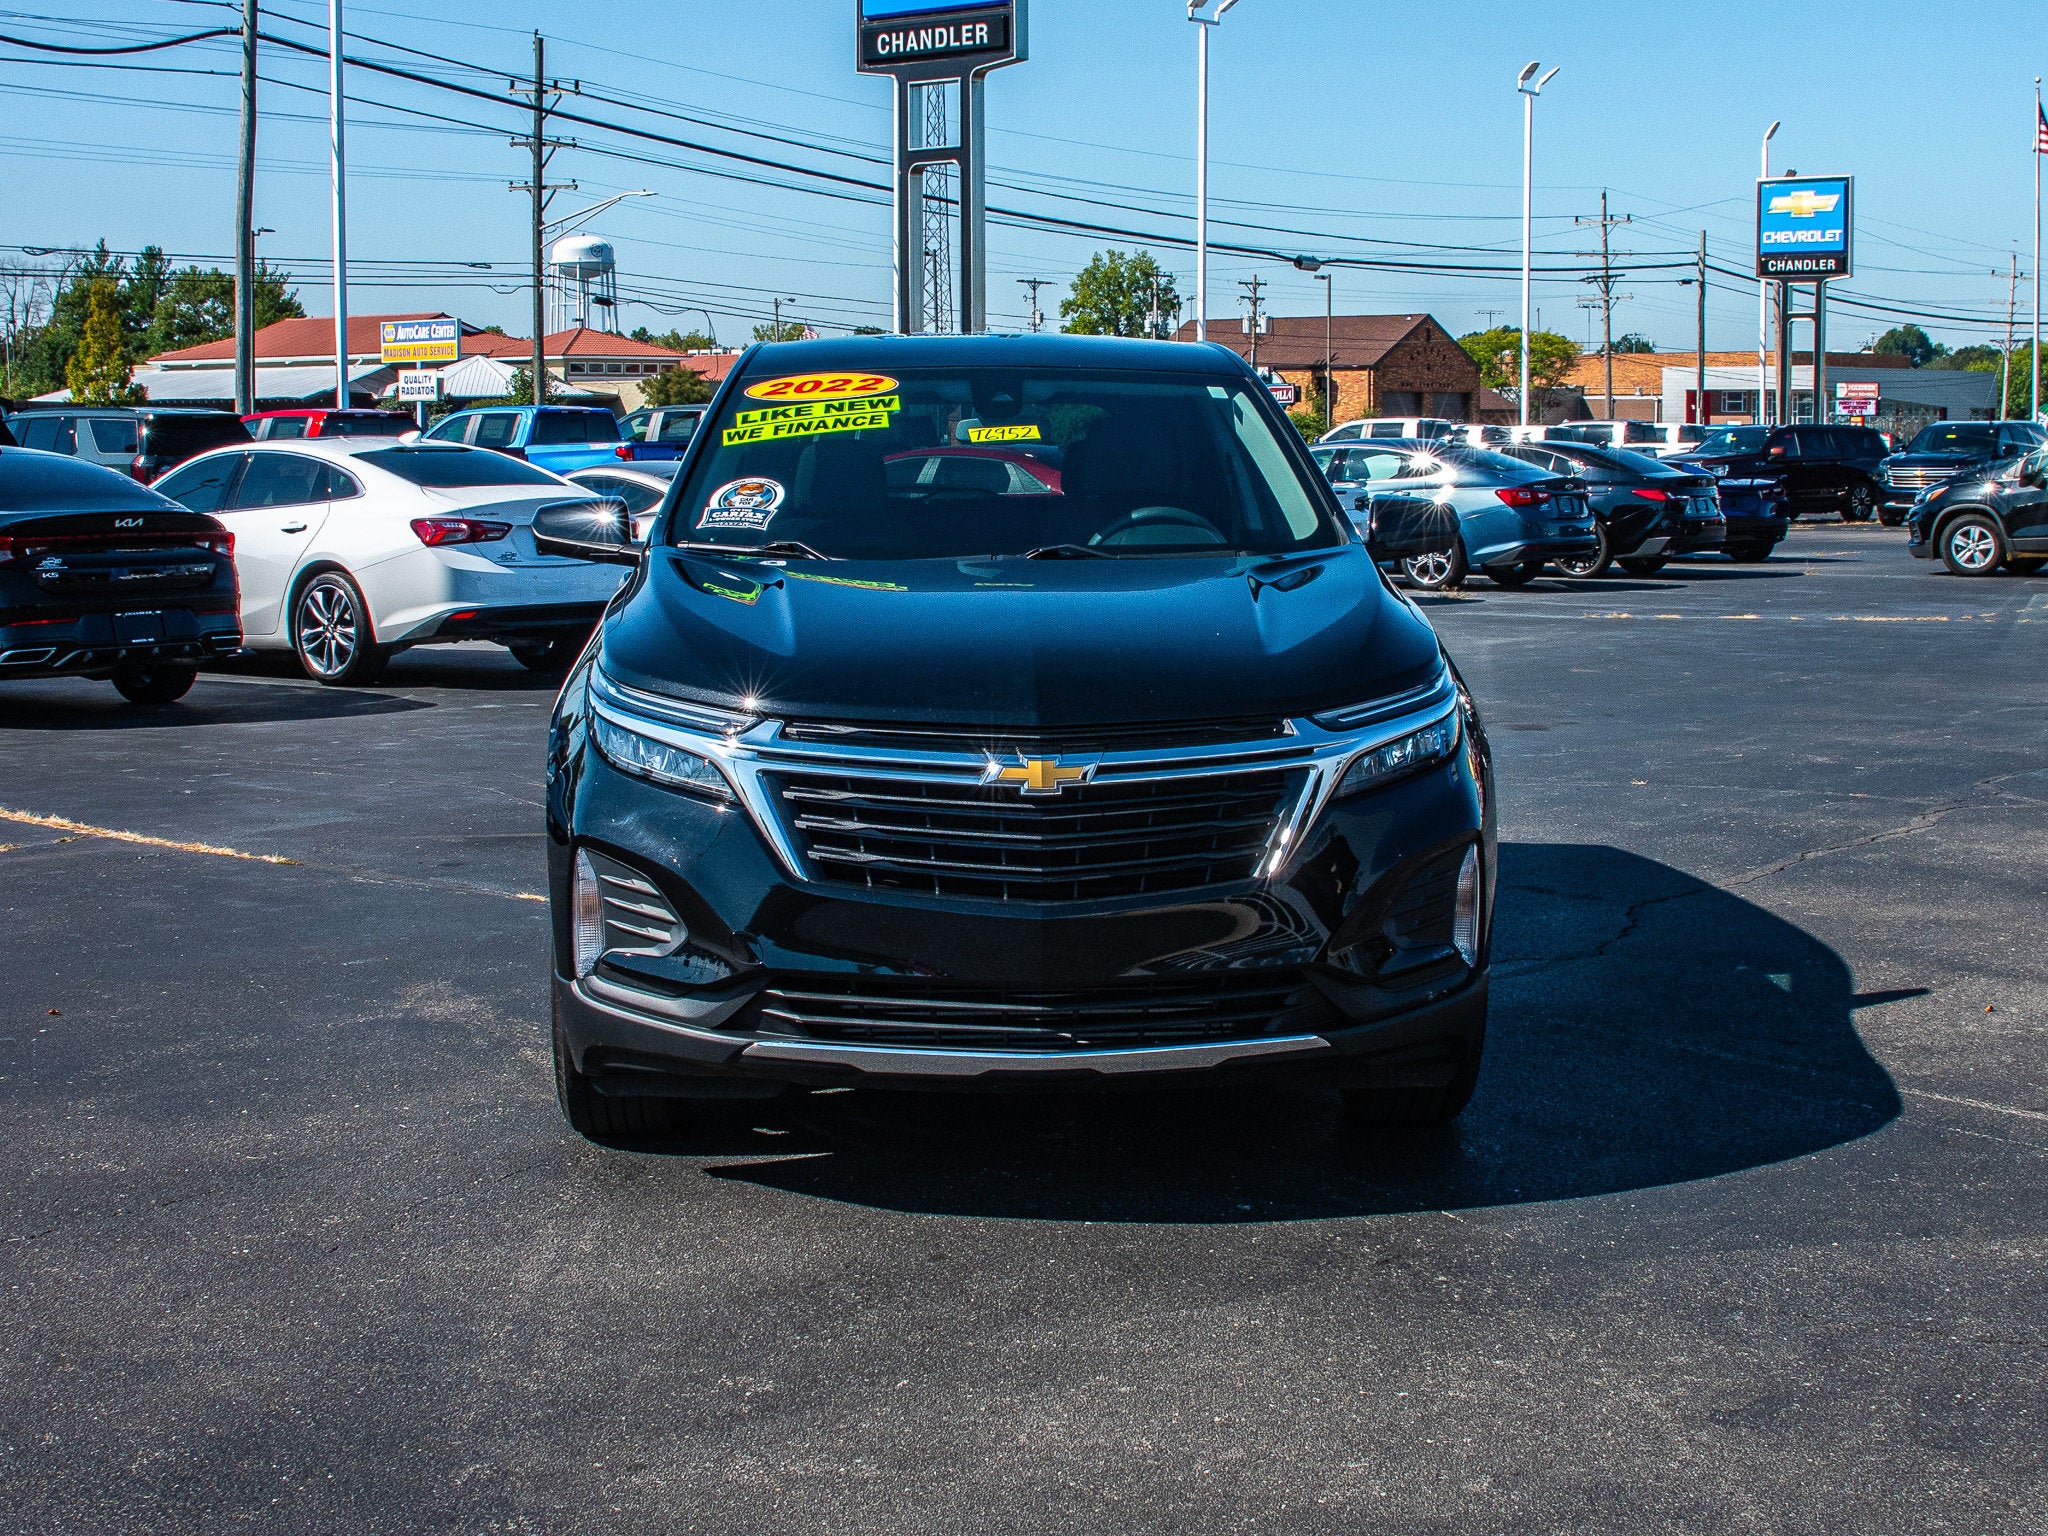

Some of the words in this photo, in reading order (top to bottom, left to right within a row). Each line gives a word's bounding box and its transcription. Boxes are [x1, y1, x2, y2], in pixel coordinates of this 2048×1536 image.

[877, 22, 988, 54] CHANDLER
[1762, 229, 1842, 244] CHEVROLET
[1768, 259, 1836, 271] CHANDLER
[384, 348, 411, 358] MADISON
[413, 347, 428, 357] AUTO
[430, 345, 454, 356] SERVICE
[404, 375, 431, 384] QUALITY
[761, 377, 885, 396] 2022
[401, 386, 435, 395] RADIATOR
[741, 405, 814, 425] LIKE
[823, 397, 896, 414] NEW
[726, 427, 765, 442] WE
[773, 414, 884, 435] FINANCE
[971, 426, 1035, 440] T6952
[711, 511, 766, 519] CARFAX
